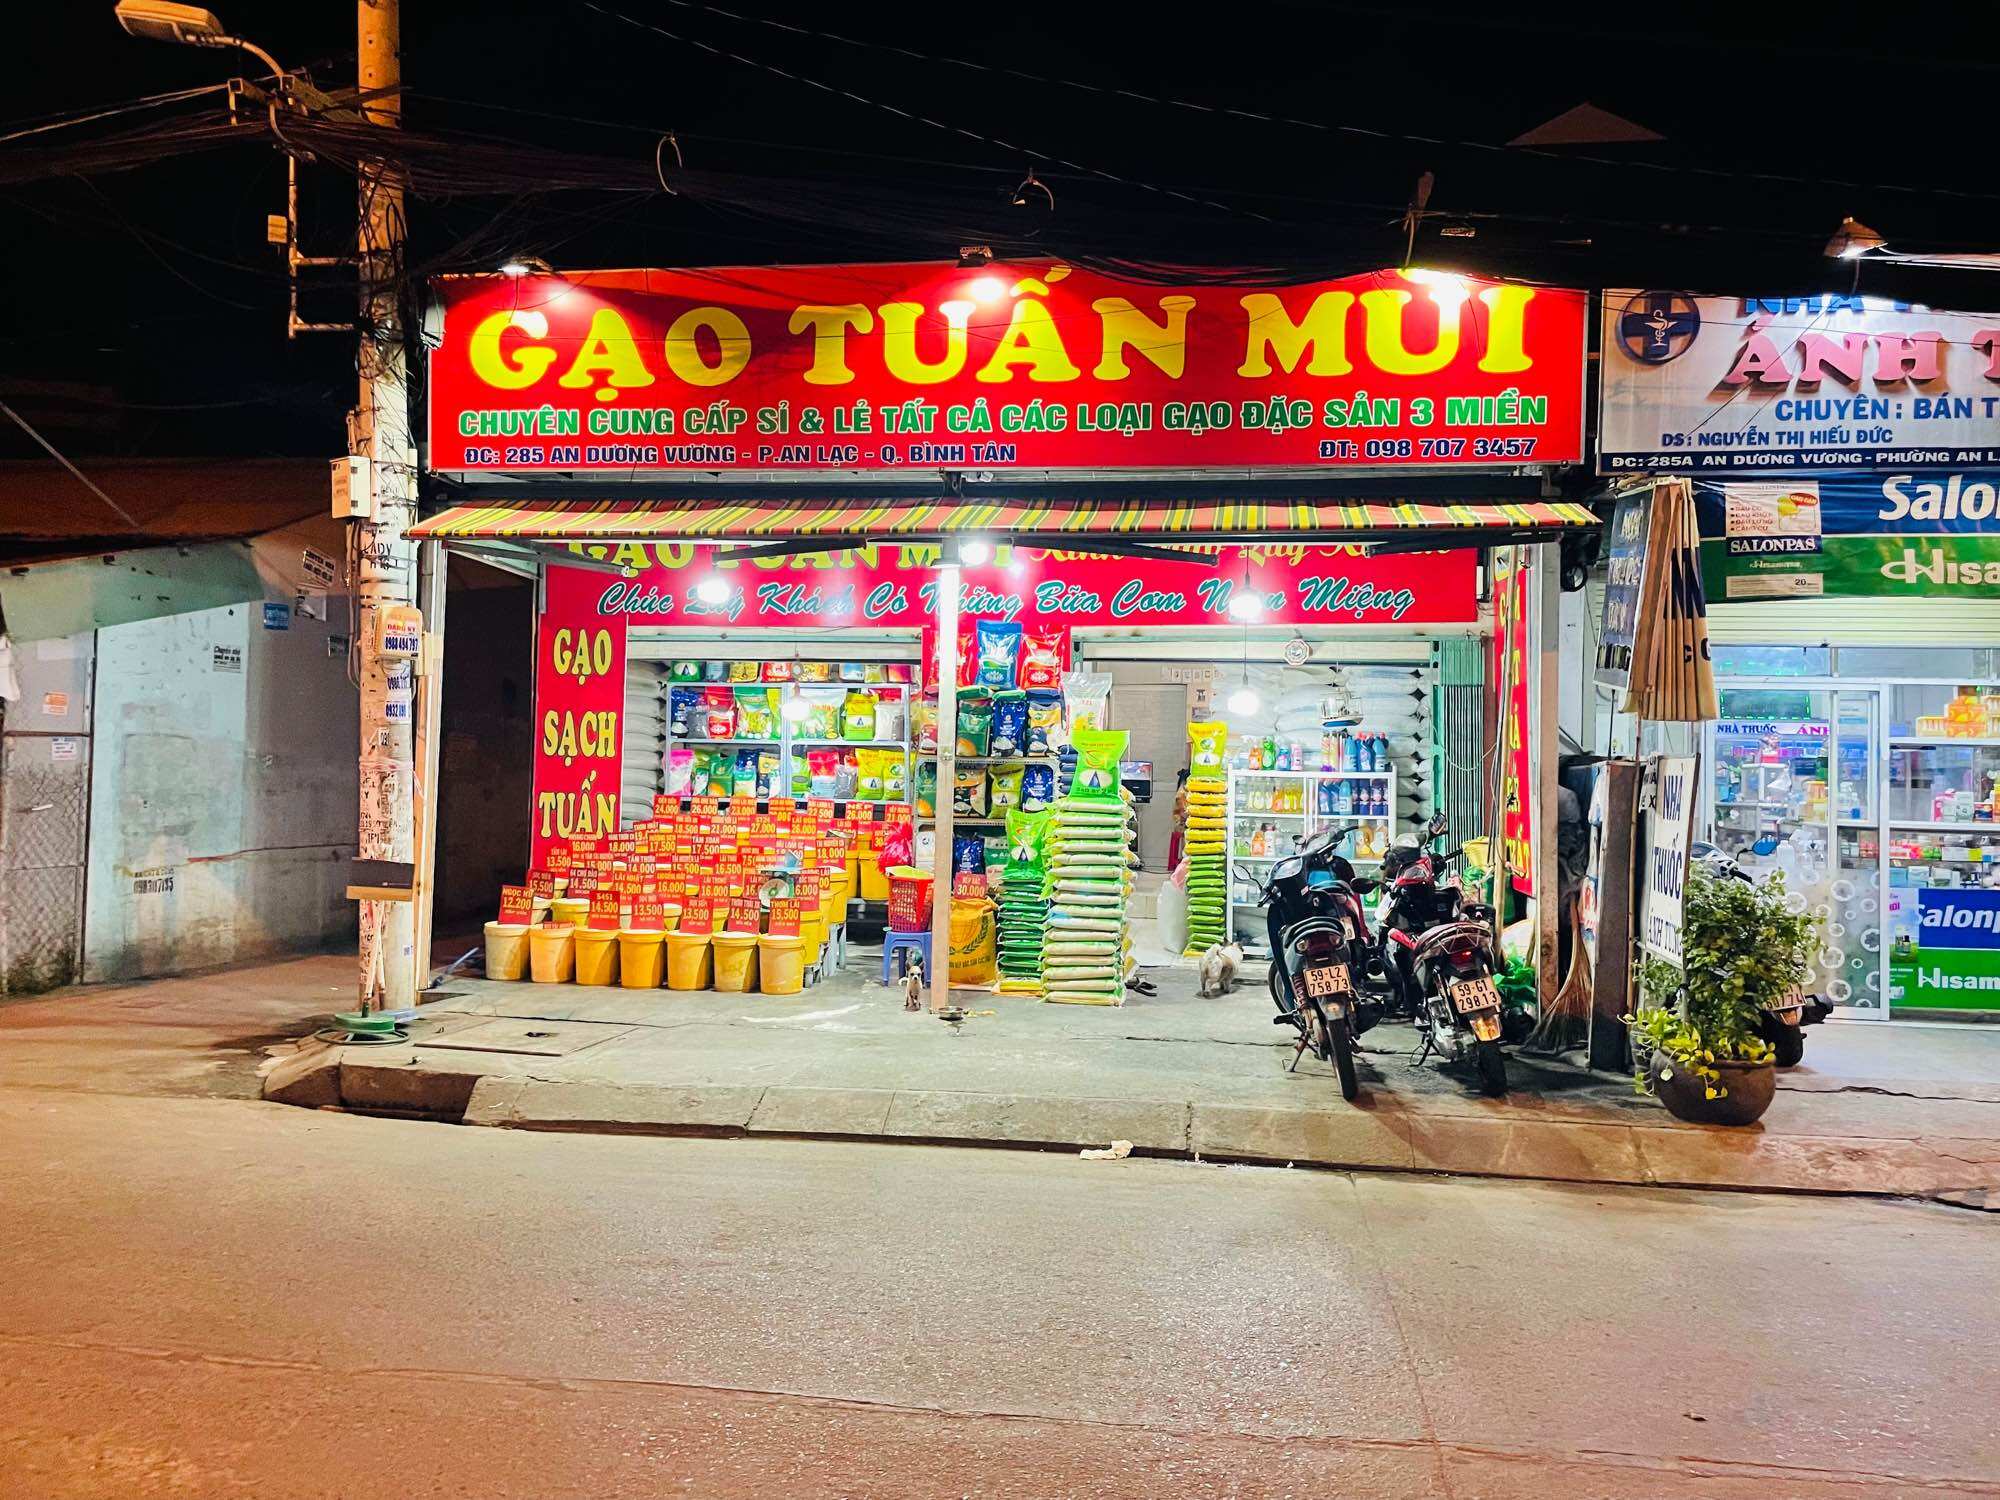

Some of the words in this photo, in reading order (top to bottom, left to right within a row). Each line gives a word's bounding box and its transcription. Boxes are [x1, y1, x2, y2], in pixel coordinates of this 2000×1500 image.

[469, 307, 751, 401] GẠO
[788, 266, 1196, 385] TUẤN
[1726, 314, 1945, 384] ÁNH
[1913, 391, 1973, 419] BÁN
[459, 404, 579, 436] CHUYÊN
[589, 408, 674, 436] CUNG
[683, 400, 748, 435] CẤP
[757, 400, 790, 434] SỈ
[800, 408, 824, 433] &
[834, 399, 872, 434] LẺ
[881, 397, 938, 434] TẤT
[947, 398, 994, 433] CẢ
[1001, 399, 1067, 432] CÁC
[1077, 402, 1152, 436] LOẠI
[1163, 401, 1232, 435] GẠO
[1240, 395, 1312, 434] ĐẶC
[1324, 390, 1400, 427] SẢN
[1410, 398, 1435, 426] 3
[1445, 388, 1548, 426] MIỀN
[1699, 425, 1769, 446] NGUYỄN
[1775, 430, 1805, 448] THỊ
[1810, 424, 1850, 444] HIẾU
[1856, 425, 1893, 443] ĐỨC
[464, 447, 500, 463] ĐC:
[505, 447, 544, 463] 285
[550, 447, 579, 463] AN
[586, 444, 657, 463] DƯƠNG
[665, 444, 735, 463] VƯƠNG
[758, 445, 811, 463] P.AN
[818, 445, 859, 466] LẠC
[881, 445, 903, 463] Q.
[910, 442, 964, 462] BÌNH
[972, 441, 1016, 462] TÂN
[1319, 440, 1358, 459] ĐT:
[1365, 439, 1411, 458] 098
[1419, 439, 1466, 457] 707
[1473, 438, 1537, 457] 3457
[1647, 455, 1693, 467] 285A
[1702, 454, 1727, 466] AN
[1733, 452, 1795, 465] DƯƠNG
[1801, 451, 1862, 464] VƯƠNG
[1876, 449, 1950, 464] PHƯỜNG
[1956, 452, 1981, 463] AN
[1879, 474, 2000, 521] Salo
[1731, 538, 1816, 552] SALONPAS
[597, 582, 674, 616] Chúc
[863, 580, 909, 620] Có
[1034, 579, 1103, 614] Bữa
[1110, 577, 1186, 618] Cơm
[1298, 576, 1415, 621] Miệng
[553, 628, 613, 686] GẠO
[1717, 722, 1739, 734] NHÀ
[543, 710, 617, 767] SẠCH
[539, 769, 617, 840] TUẤN
[691, 804, 718, 815] 26.000
[846, 810, 873, 820] 26.000
[711, 824, 737, 834] 21.000
[751, 823, 776, 834] 27.000
[572, 841, 596, 852] 16.000
[608, 842, 635, 852] 18.000
[650, 841, 676, 852] 17.500
[692, 844, 720, 855] 17.500
[817, 847, 845, 858] 18.000
[546, 857, 571, 867] 13.500
[715, 863, 742, 875] 16.500
[570, 878, 598, 889] 14.500
[615, 882, 642, 894] 14.500
[658, 882, 685, 893] 16.000
[702, 885, 728, 896] 16.000
[957, 885, 985, 897] 30.000
[503, 897, 532, 910] 12.200
[591, 901, 619, 913] 14.500
[635, 904, 663, 916] 13.500
[683, 908, 709, 920] 13.500
[730, 907, 760, 920] 14.500
[772, 909, 799, 920] 15.500
[1310, 967, 1342, 981] 59-L2
[1310, 980, 1349, 996] 758.73
[1457, 980, 1488, 996] 59-G1
[1459, 992, 1498, 1011] 298.13
